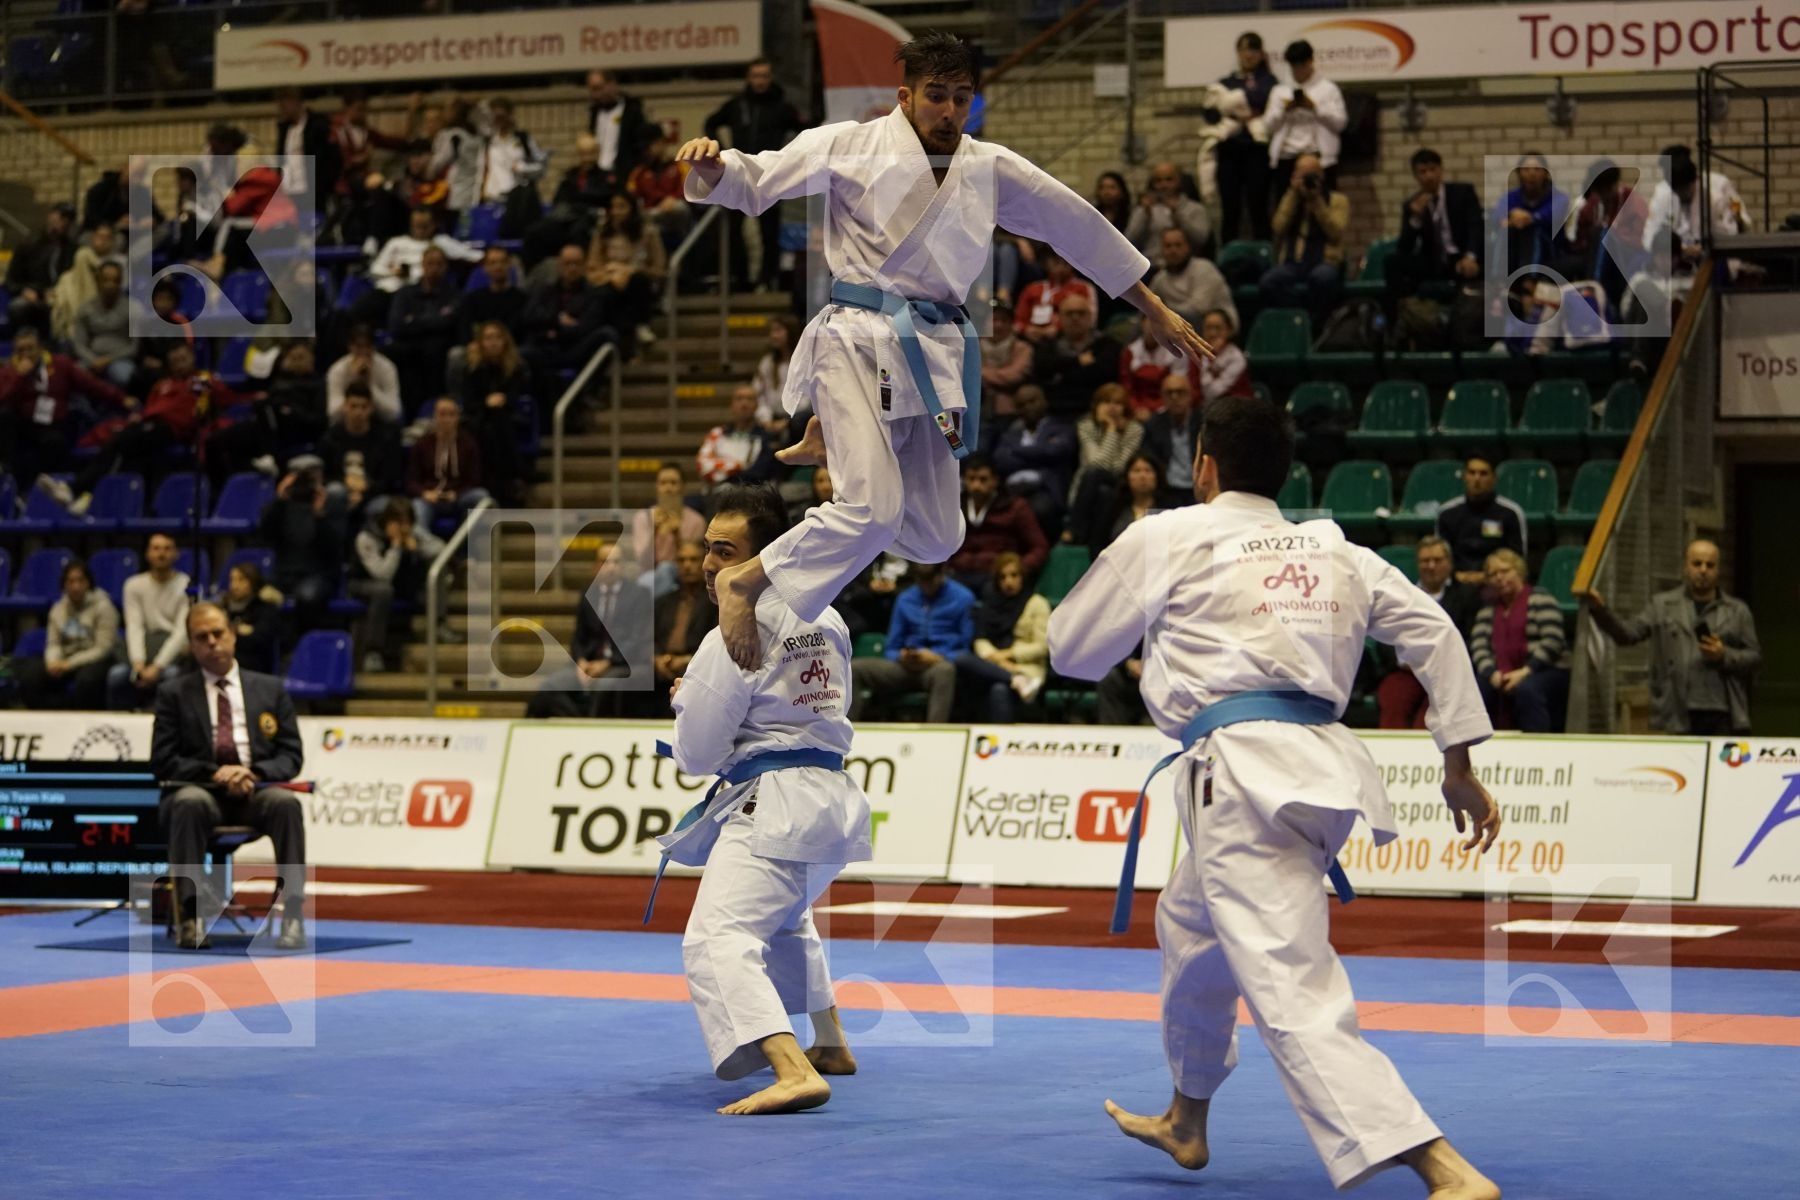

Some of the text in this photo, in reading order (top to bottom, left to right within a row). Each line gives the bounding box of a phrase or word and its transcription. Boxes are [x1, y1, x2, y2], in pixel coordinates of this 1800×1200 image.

[321, 21, 739, 70] Topsportcentrum Rotterdam
[1518, 6, 1800, 68] Topsportc
[1736, 352, 1797, 380] Tops
[1241, 536, 1321, 554] IRI2275
[1251, 600, 1340, 617] AJINOMOTO
[793, 689, 841, 706] AJINOMOTO
[314, 777, 404, 801] Karate
[967, 786, 1070, 813] Karate
[420, 785, 464, 822] Tv
[21, 819, 53, 831] ITALY
[1498, 840, 1522, 872] 12
[1531, 840, 1565, 874] 00
